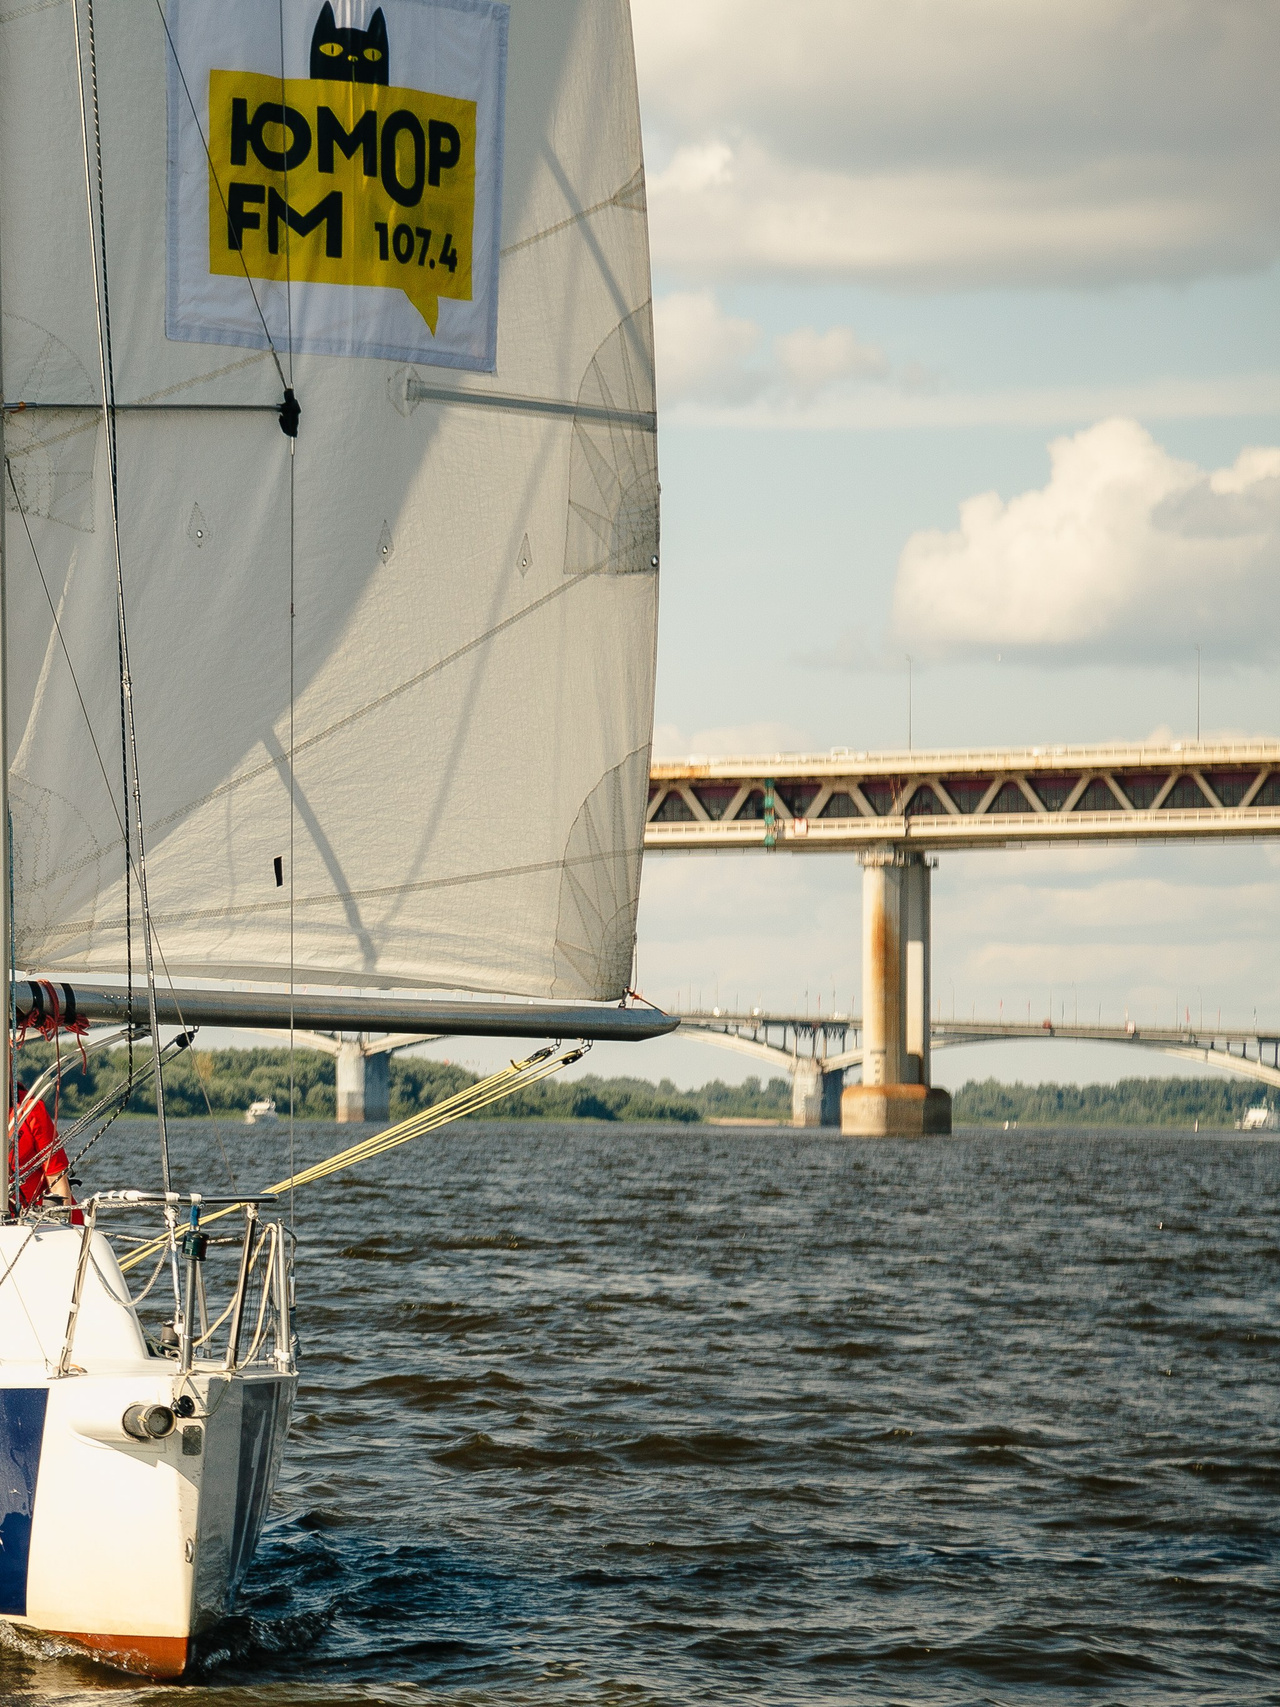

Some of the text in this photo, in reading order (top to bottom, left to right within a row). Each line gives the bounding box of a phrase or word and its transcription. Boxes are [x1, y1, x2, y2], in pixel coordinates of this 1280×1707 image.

[230, 97, 461, 207] ЮМОР
[227, 182, 458, 273] FM 107.4
